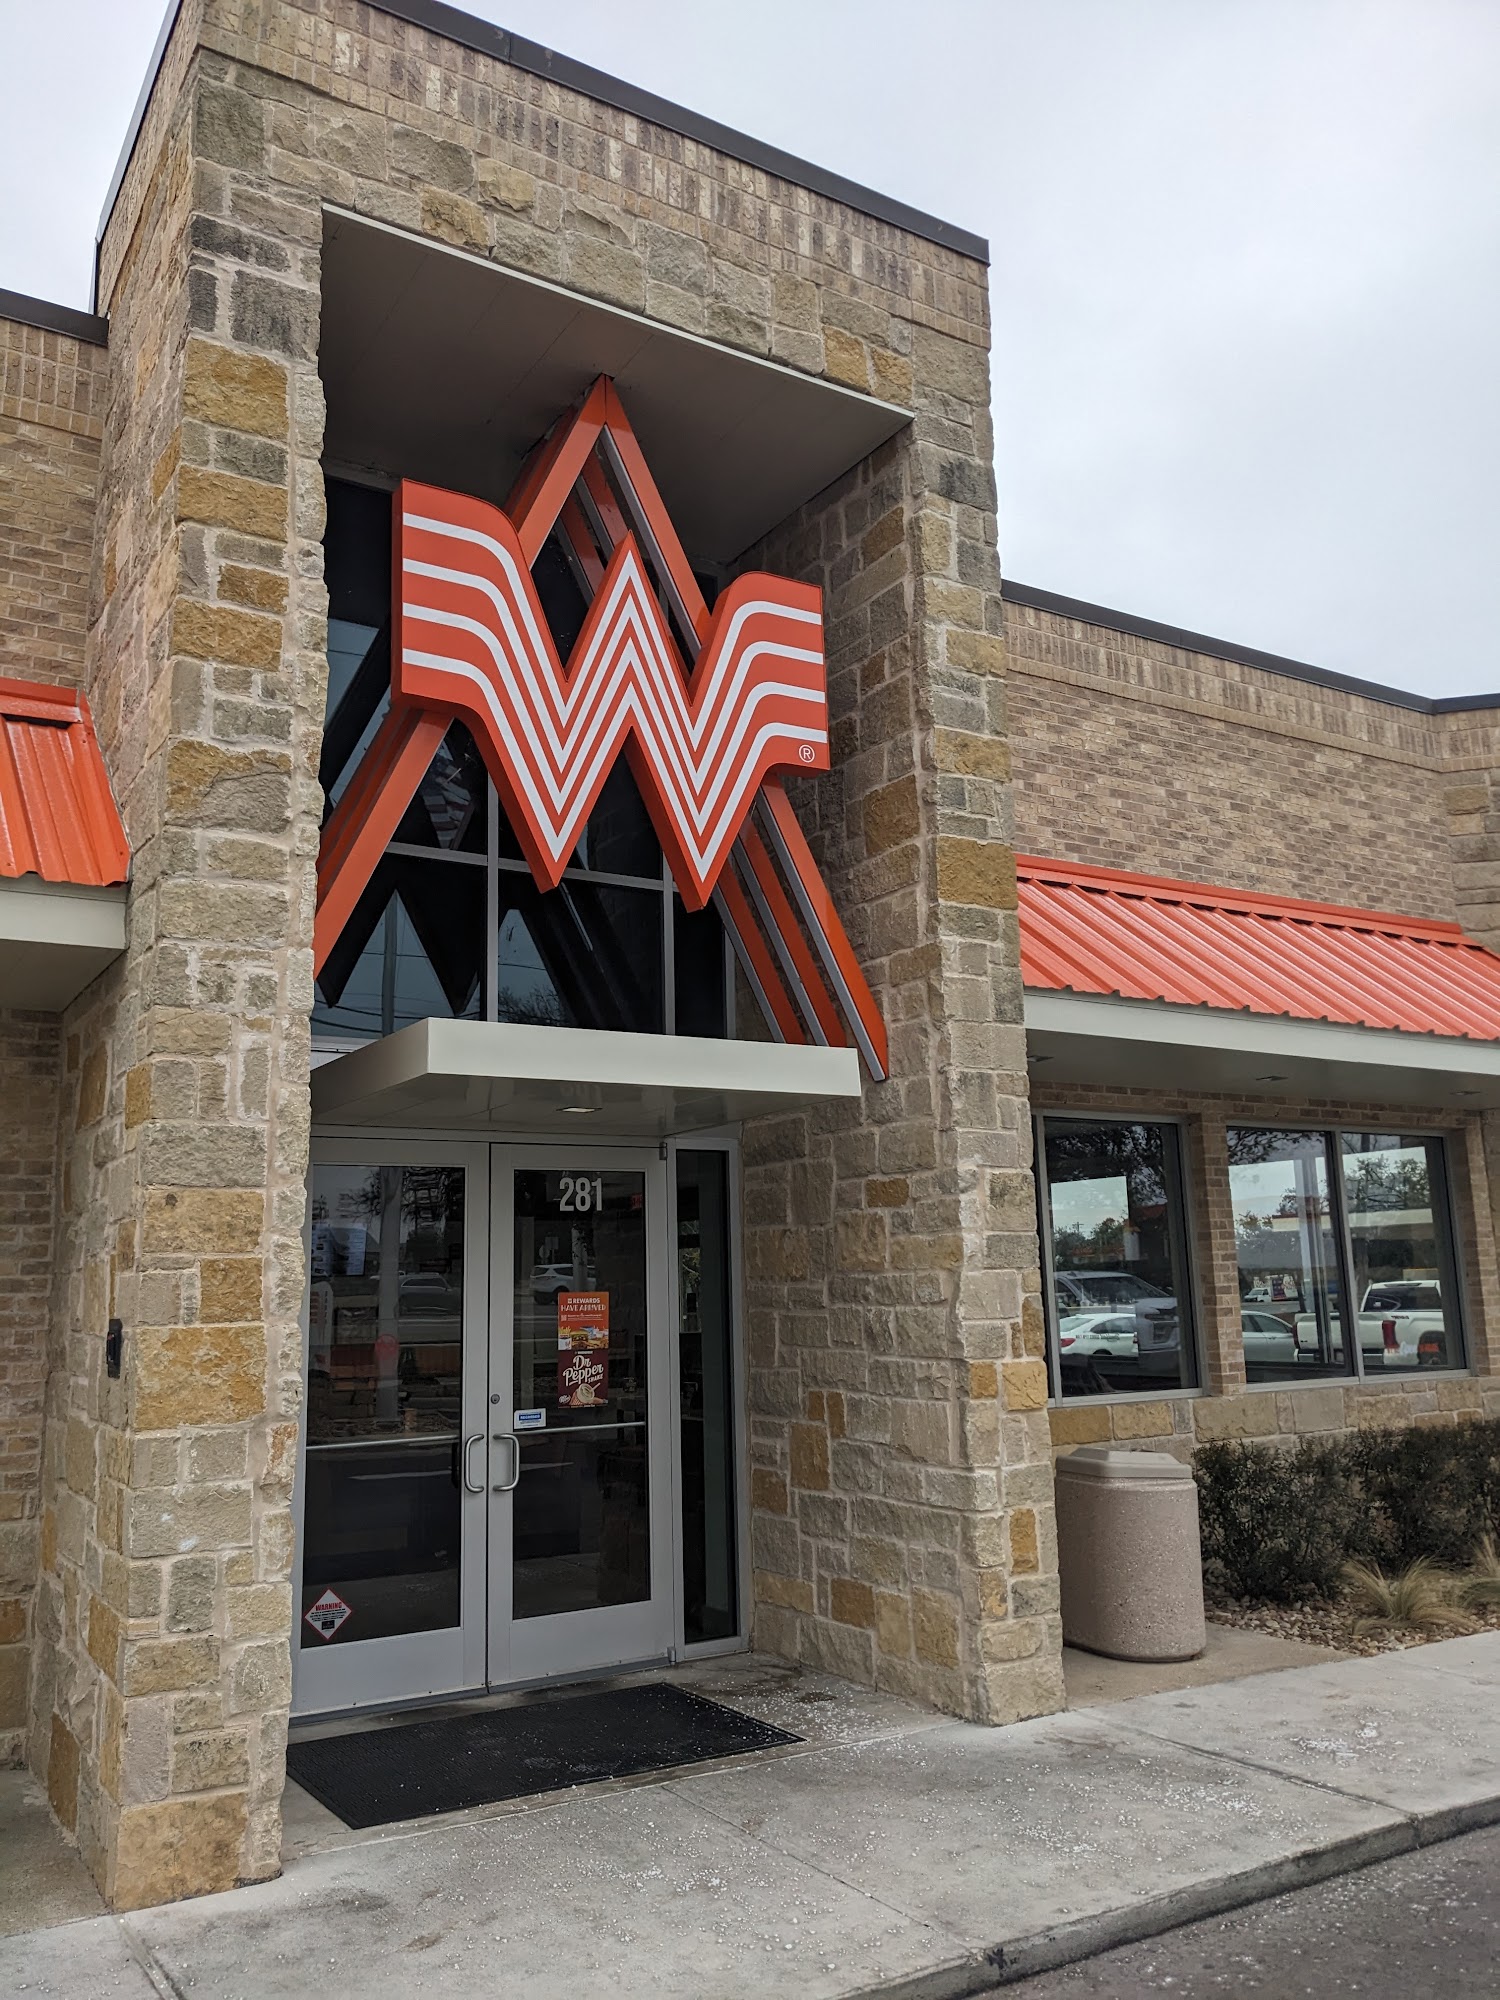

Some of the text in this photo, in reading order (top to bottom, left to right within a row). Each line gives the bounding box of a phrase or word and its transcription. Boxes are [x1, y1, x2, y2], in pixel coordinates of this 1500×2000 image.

[400, 478, 830, 911] W
[559, 1177, 602, 1212] 281
[560, 1304, 578, 1312] HAVE
[572, 1354, 591, 1371] Dr
[562, 1363, 604, 1387] Pepper
[587, 1374, 604, 1383] SHAKE
[315, 1602, 342, 1611] WARNING
